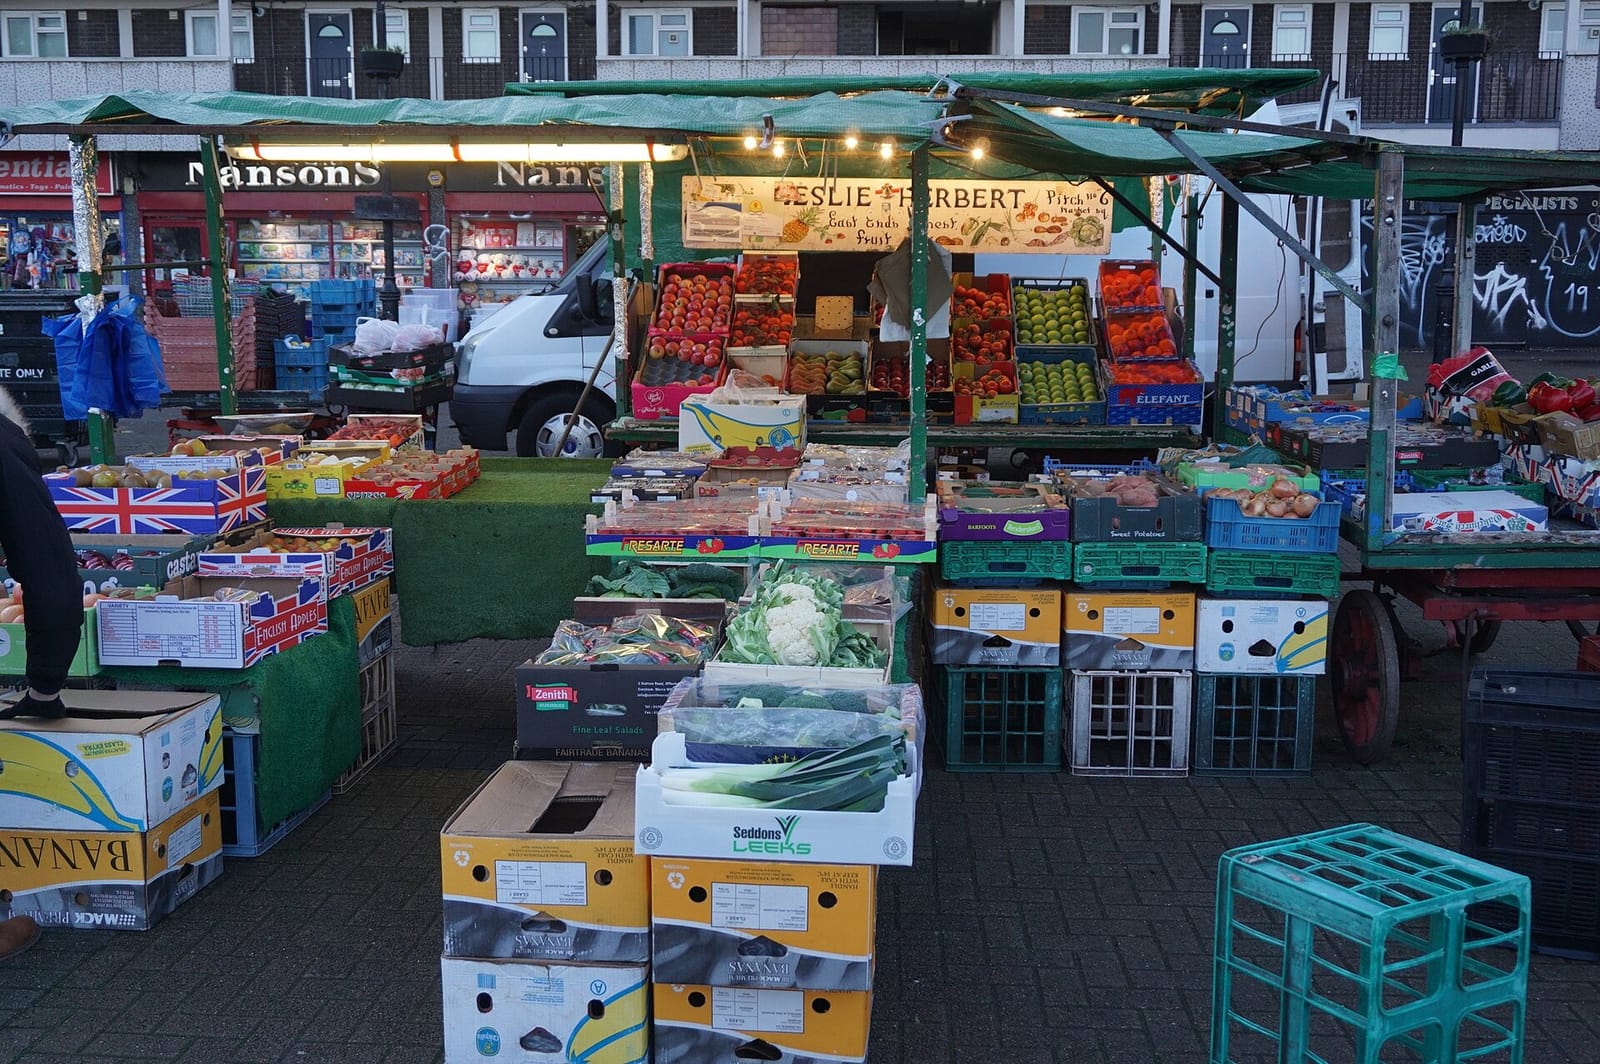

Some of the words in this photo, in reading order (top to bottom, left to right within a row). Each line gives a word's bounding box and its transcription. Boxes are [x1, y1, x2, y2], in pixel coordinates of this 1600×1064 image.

[0, 155, 99, 178] entia
[784, 185, 872, 207] ESLIE
[1047, 189, 1084, 206] Pitch
[1099, 190, 1109, 206] 6
[1485, 196, 1579, 211] ECIALISTS
[15, 368, 45, 379] ONLY
[1136, 394, 1190, 405] ELEFANT
[698, 486, 720, 497] Dole
[621, 537, 685, 553] FRESARTE
[797, 540, 860, 557] FRESARTE
[256, 619, 287, 646] ENGLISH
[290, 608, 318, 632] APPLES
[535, 689, 568, 699] Zenith
[573, 725, 591, 734] Fine
[594, 725, 612, 734] Leaf
[615, 725, 643, 734] Salads
[555, 748, 604, 757] FAIRTRADE
[606, 748, 649, 757] BANANAS
[733, 825, 782, 840] Seddons
[733, 840, 811, 855] LEEKS
[75, 912, 119, 926] MACK
[515, 935, 573, 948] BANANAS
[728, 961, 789, 975] BANANAS
